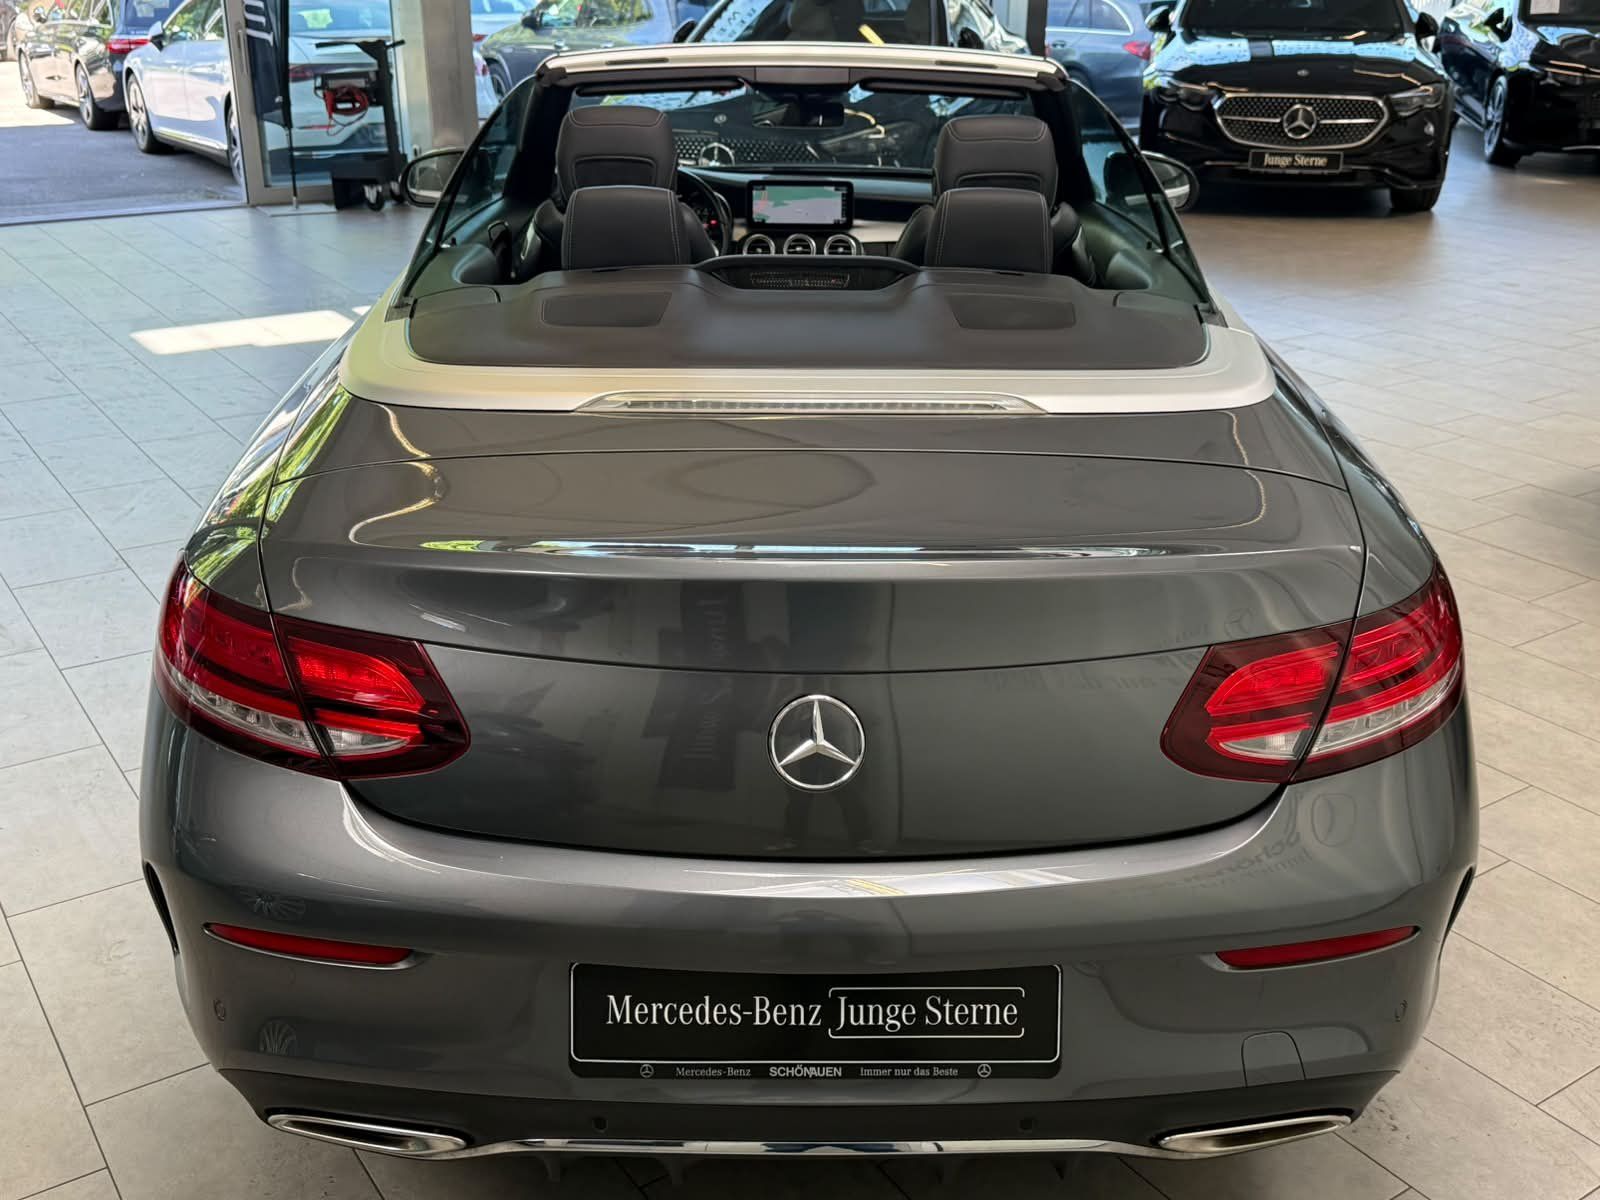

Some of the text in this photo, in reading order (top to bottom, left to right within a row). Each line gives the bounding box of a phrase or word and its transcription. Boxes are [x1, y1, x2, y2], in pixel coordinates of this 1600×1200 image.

[1263, 153, 1329, 168] Junge Sterne
[605, 994, 1019, 1033] Mercedes-Benz Junge Sterne
[675, 1066, 752, 1077] Mercedes-Benz
[860, 1066, 893, 1077] Immer
[894, 1067, 912, 1077] nur
[913, 1066, 931, 1077] das
[932, 1066, 959, 1077] Beste
